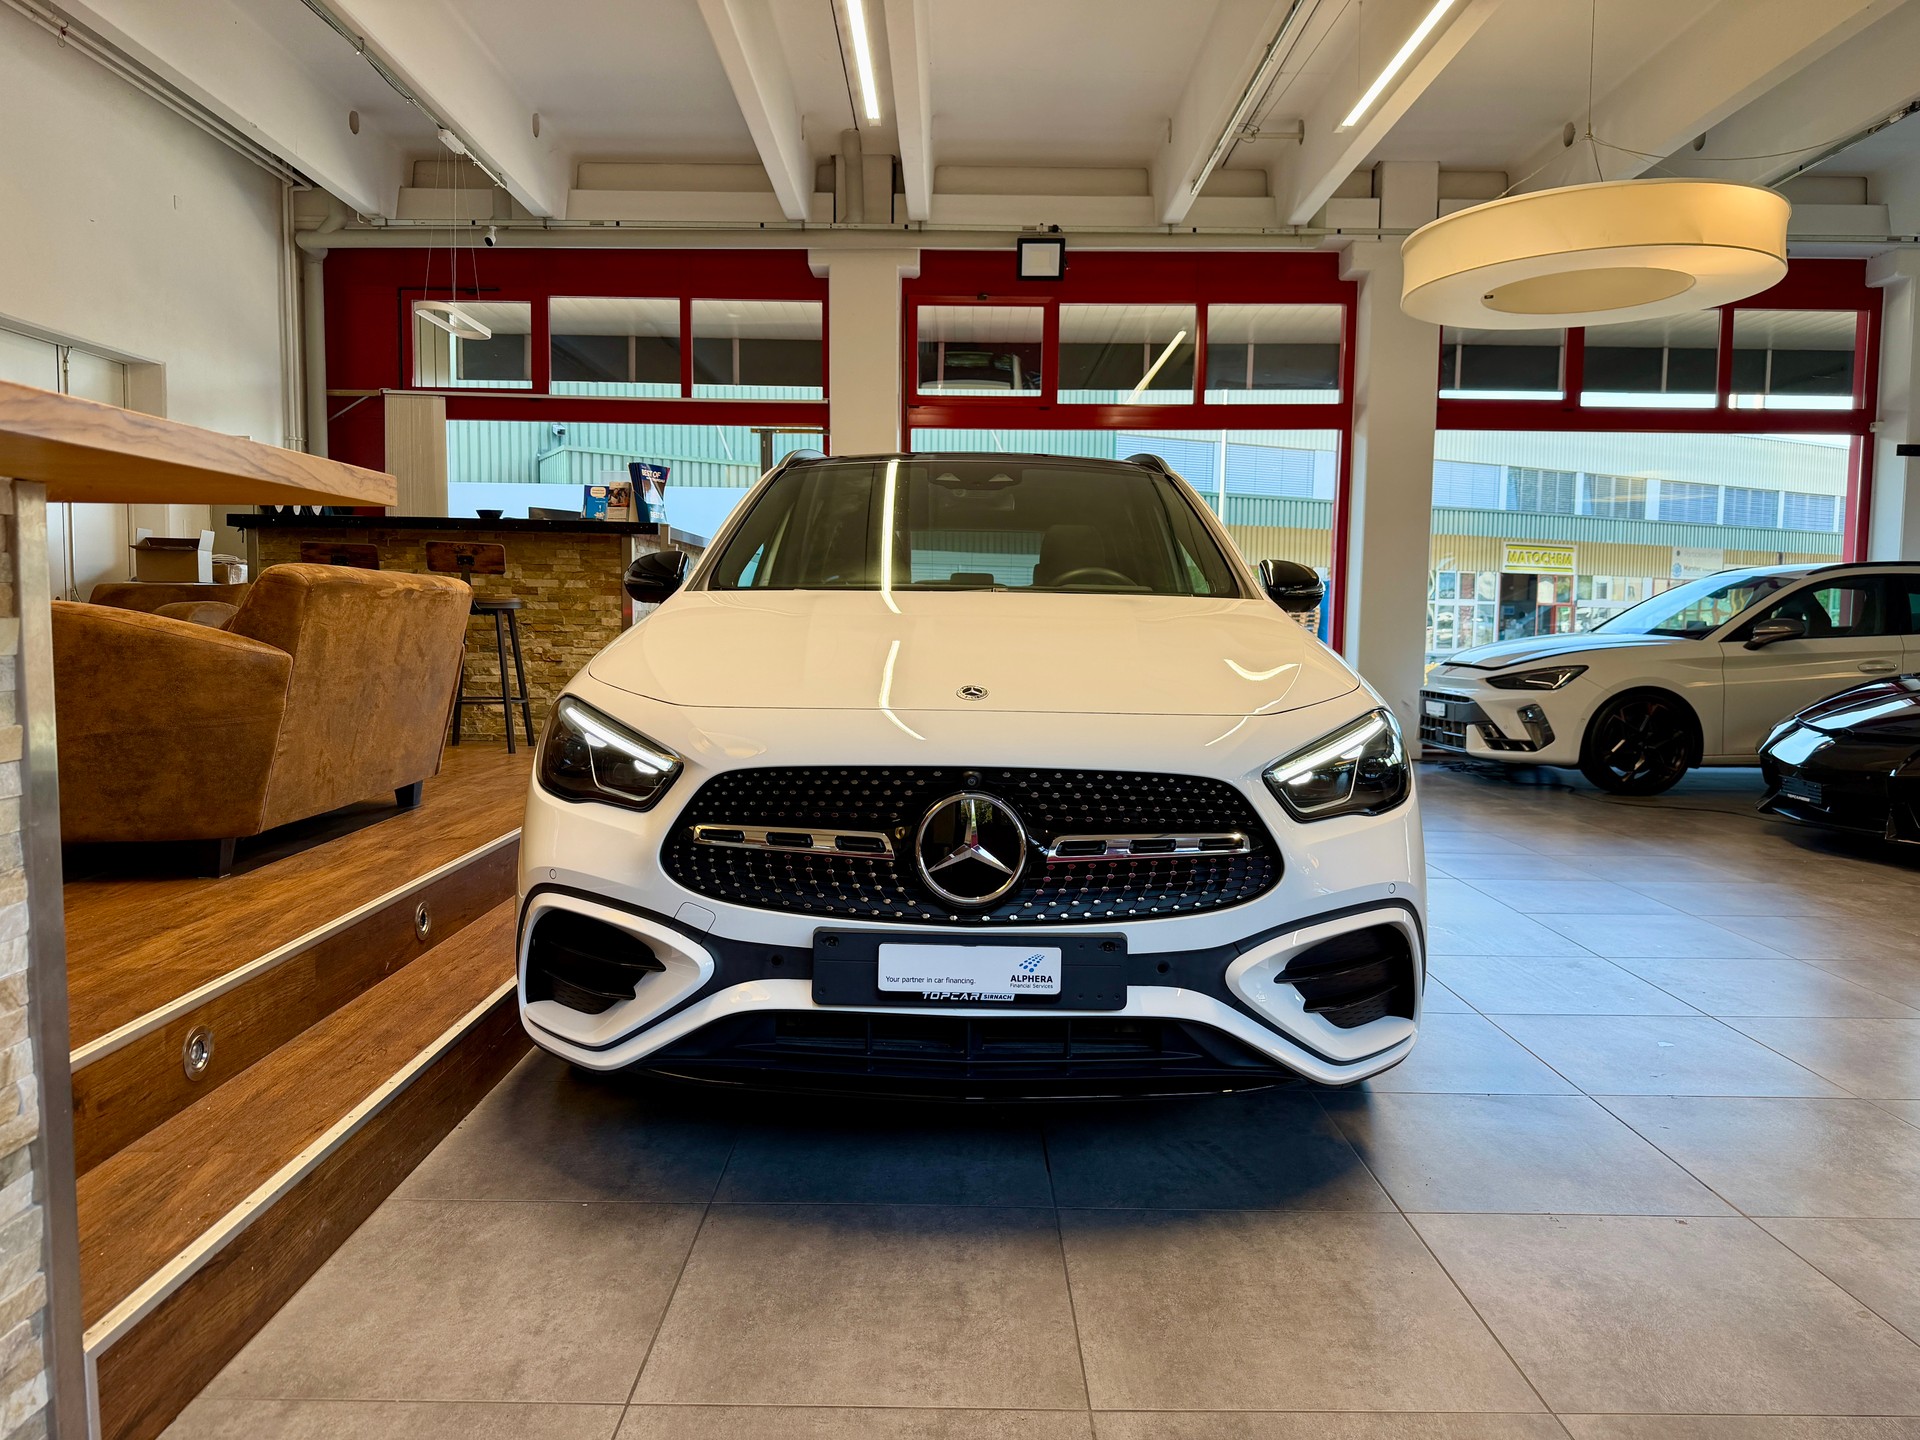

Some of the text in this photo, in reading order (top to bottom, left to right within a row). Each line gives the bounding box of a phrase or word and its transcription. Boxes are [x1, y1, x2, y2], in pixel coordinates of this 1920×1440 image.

[1507, 550, 1573, 566] MATOCHEM
[885, 975, 900, 983] Your
[901, 976, 925, 984] partner
[945, 976, 976, 985] financing.
[1010, 974, 1053, 983] ALPHERA
[922, 991, 980, 1000] TOPCAR
